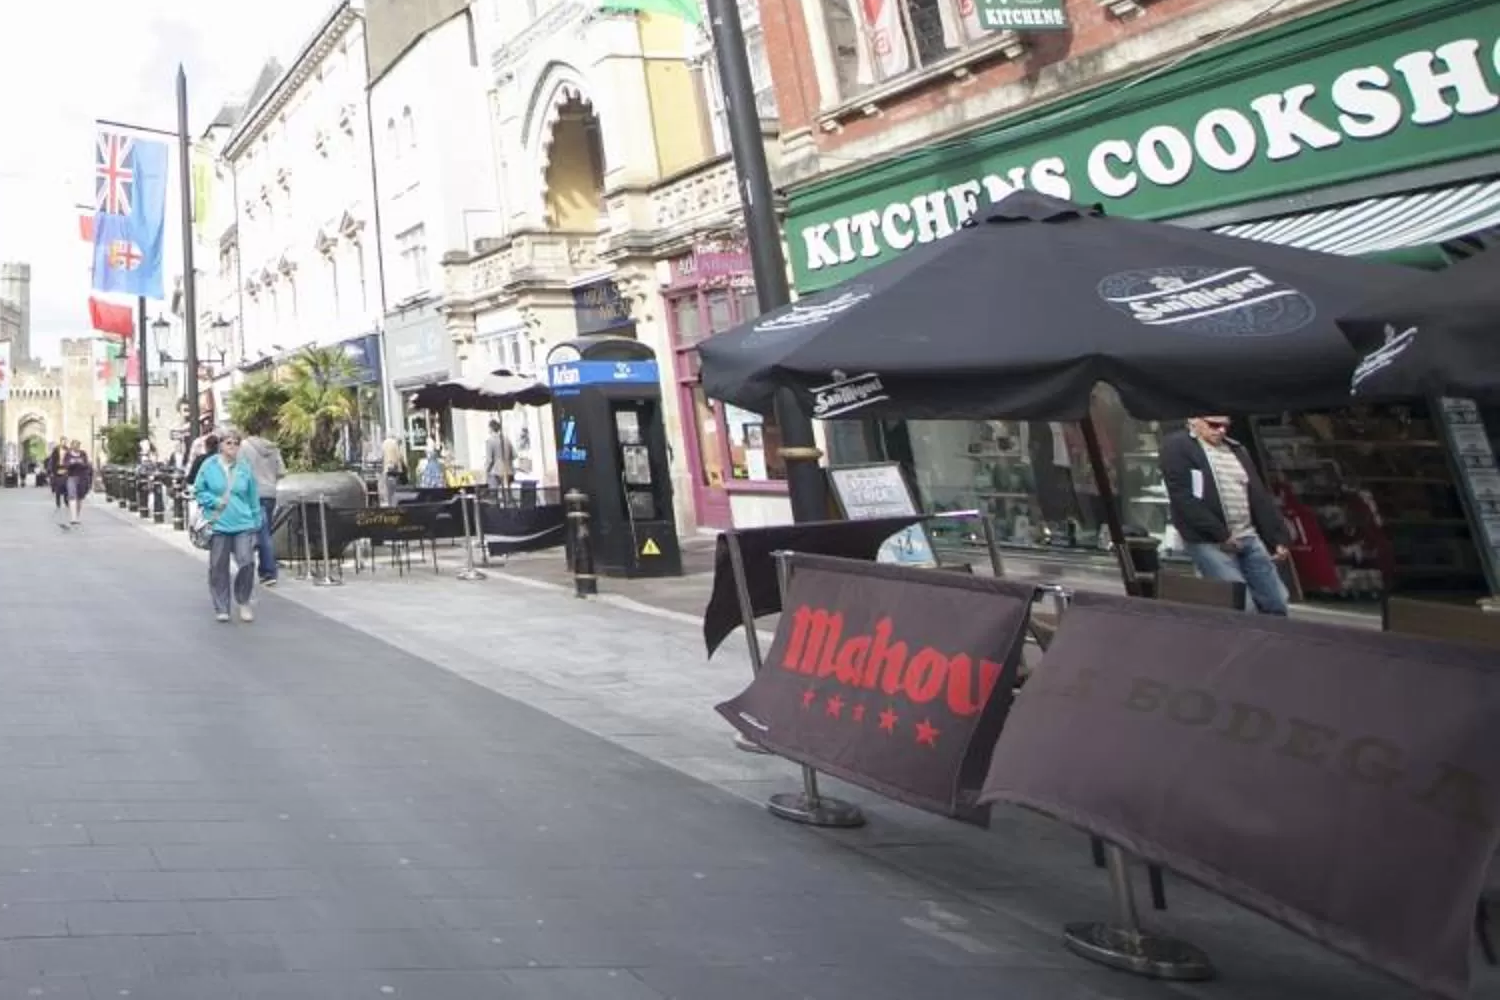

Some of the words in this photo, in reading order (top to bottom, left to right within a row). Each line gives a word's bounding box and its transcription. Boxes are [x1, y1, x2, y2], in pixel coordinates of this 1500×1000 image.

[985, 8, 1063, 25] KITCHENS
[1088, 37, 1500, 197] COOKSH
[783, 604, 1002, 716] Mahou
